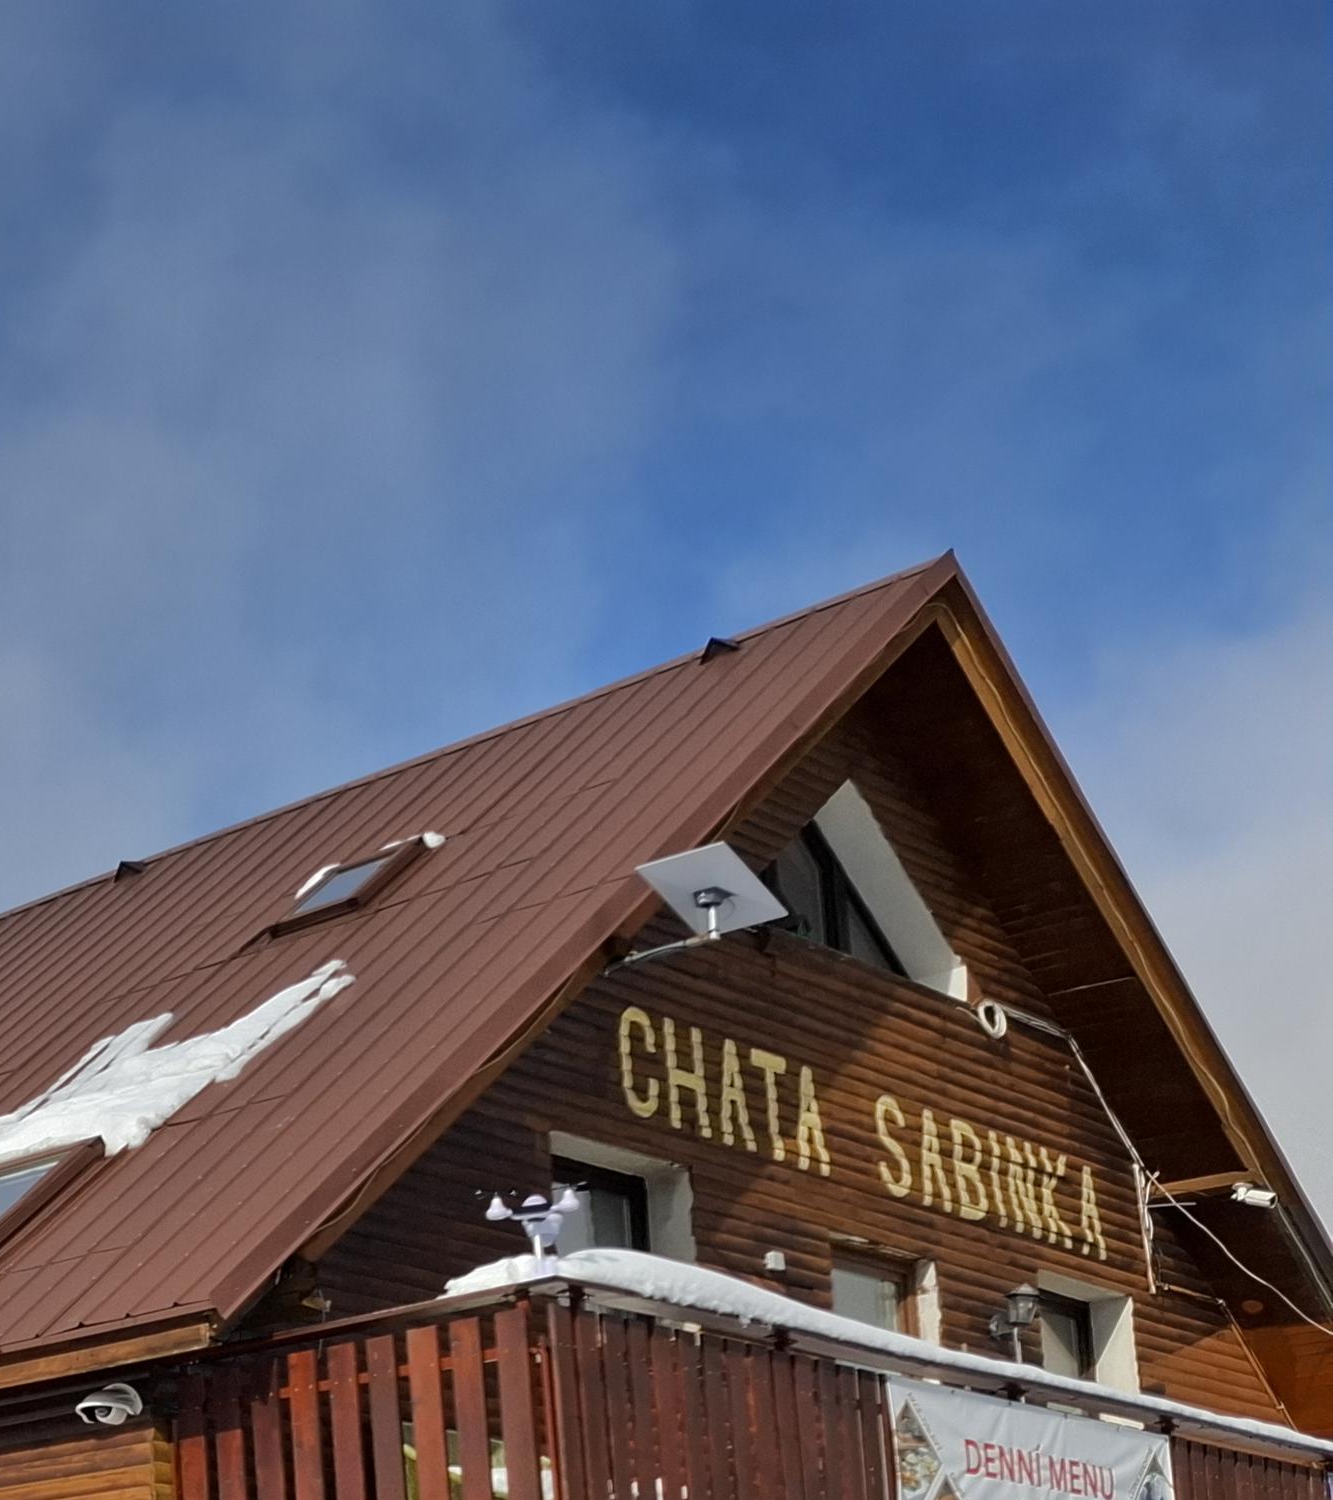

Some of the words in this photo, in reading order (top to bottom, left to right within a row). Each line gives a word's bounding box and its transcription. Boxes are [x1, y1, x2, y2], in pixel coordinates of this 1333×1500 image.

[618, 1006, 831, 1176] CHATA
[874, 1094, 1107, 1260] SABINKA
[963, 1439, 1041, 1486] DENNÍ
[1048, 1455, 1116, 1500] MENU
